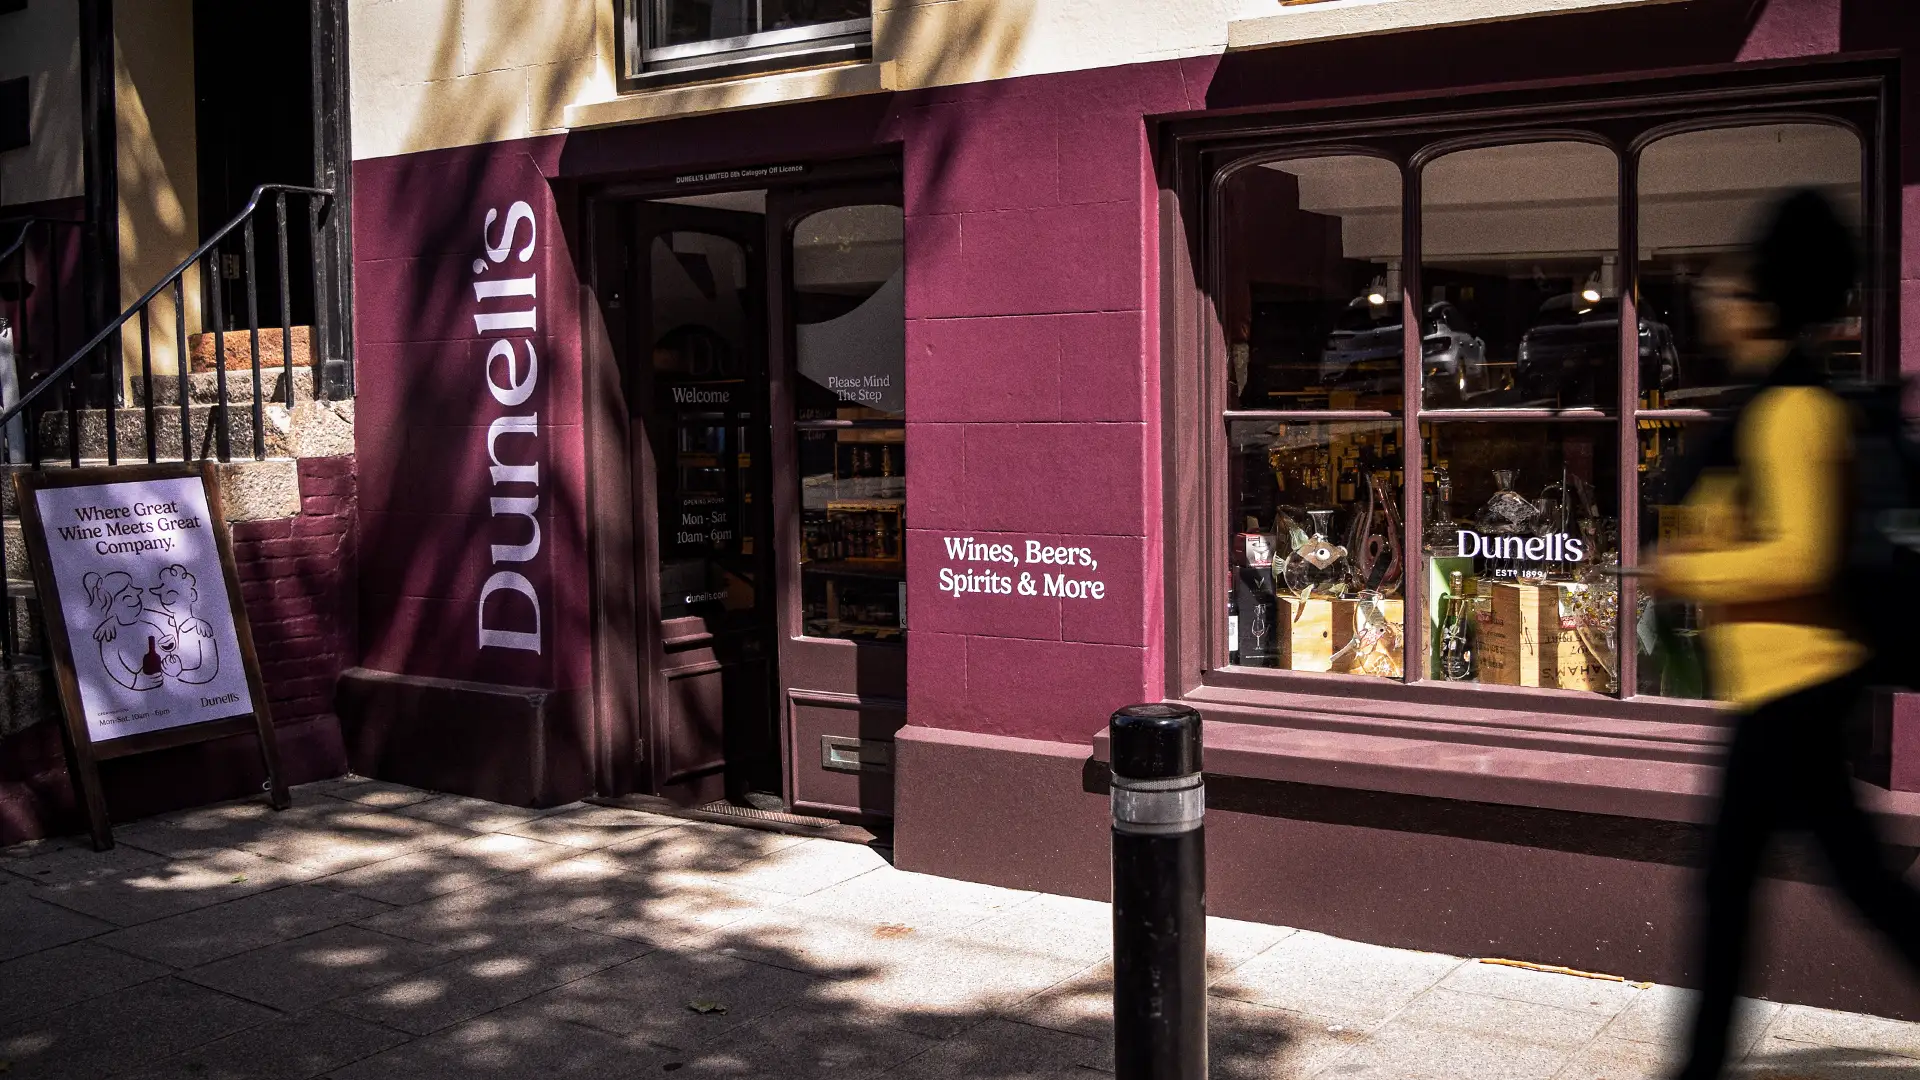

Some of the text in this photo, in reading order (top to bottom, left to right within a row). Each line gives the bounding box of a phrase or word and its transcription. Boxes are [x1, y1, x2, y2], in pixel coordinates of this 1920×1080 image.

[676, 175, 704, 184] DUNELL'S
[704, 171, 729, 181] LIMITED
[741, 168, 768, 177] Category
[768, 166, 778, 174] Off
[779, 164, 803, 173] Licence
[828, 375, 891, 389] Please Mind
[672, 387, 730, 404] Welcome
[836, 389, 883, 403] The Step
[473, 200, 542, 656] Dunell's
[75, 500, 179, 522] Where Great
[682, 512, 704, 526] Mon
[711, 511, 727, 523] Sat
[57, 515, 201, 542] Wine Meets Great
[677, 531, 703, 544] 10am
[710, 528, 732, 543] 6pm
[95, 536, 176, 556] Company.
[943, 536, 1098, 571] Wines, Beers,
[1454, 529, 1584, 562] Dunell's
[1521, 570, 1543, 578] 1899
[939, 568, 1105, 600] Spirits & More
[685, 590, 729, 604] dunells.com
[200, 692, 240, 708] Dunell's
[131, 712, 150, 721] 10am
